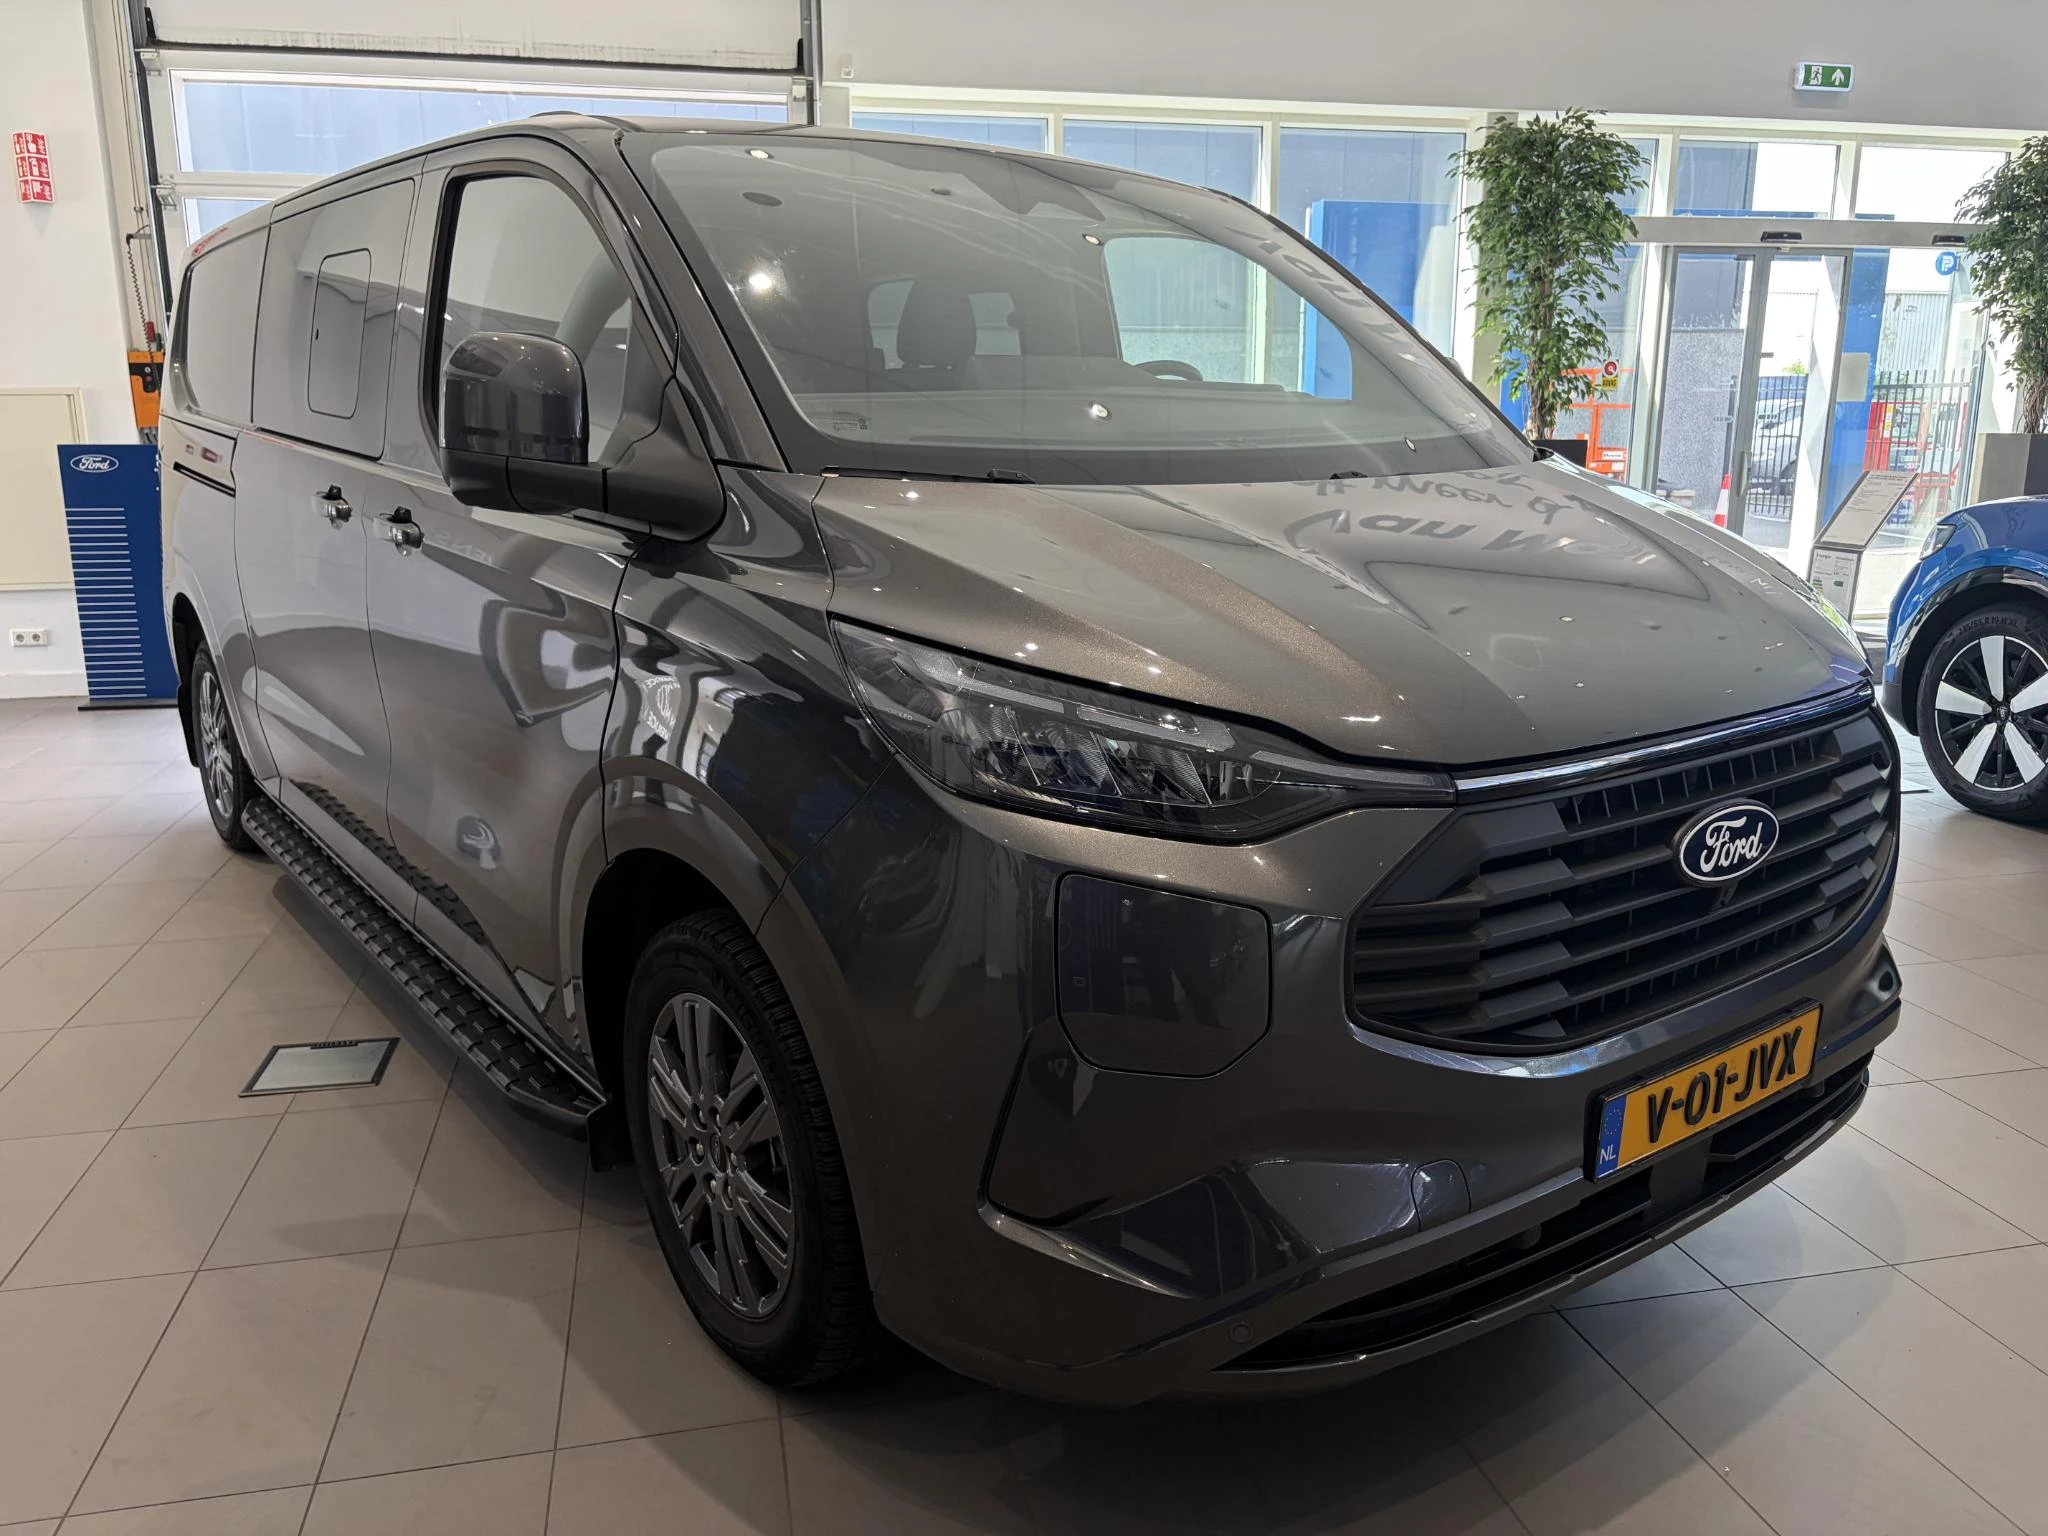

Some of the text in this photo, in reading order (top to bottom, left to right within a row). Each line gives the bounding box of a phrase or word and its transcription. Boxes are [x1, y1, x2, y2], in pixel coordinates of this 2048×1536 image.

[79, 457, 110, 470] Ford
[1700, 816, 1763, 873] Ford
[1648, 1026, 1803, 1143] V-01-JVX
[1600, 1143, 1617, 1164] NL
